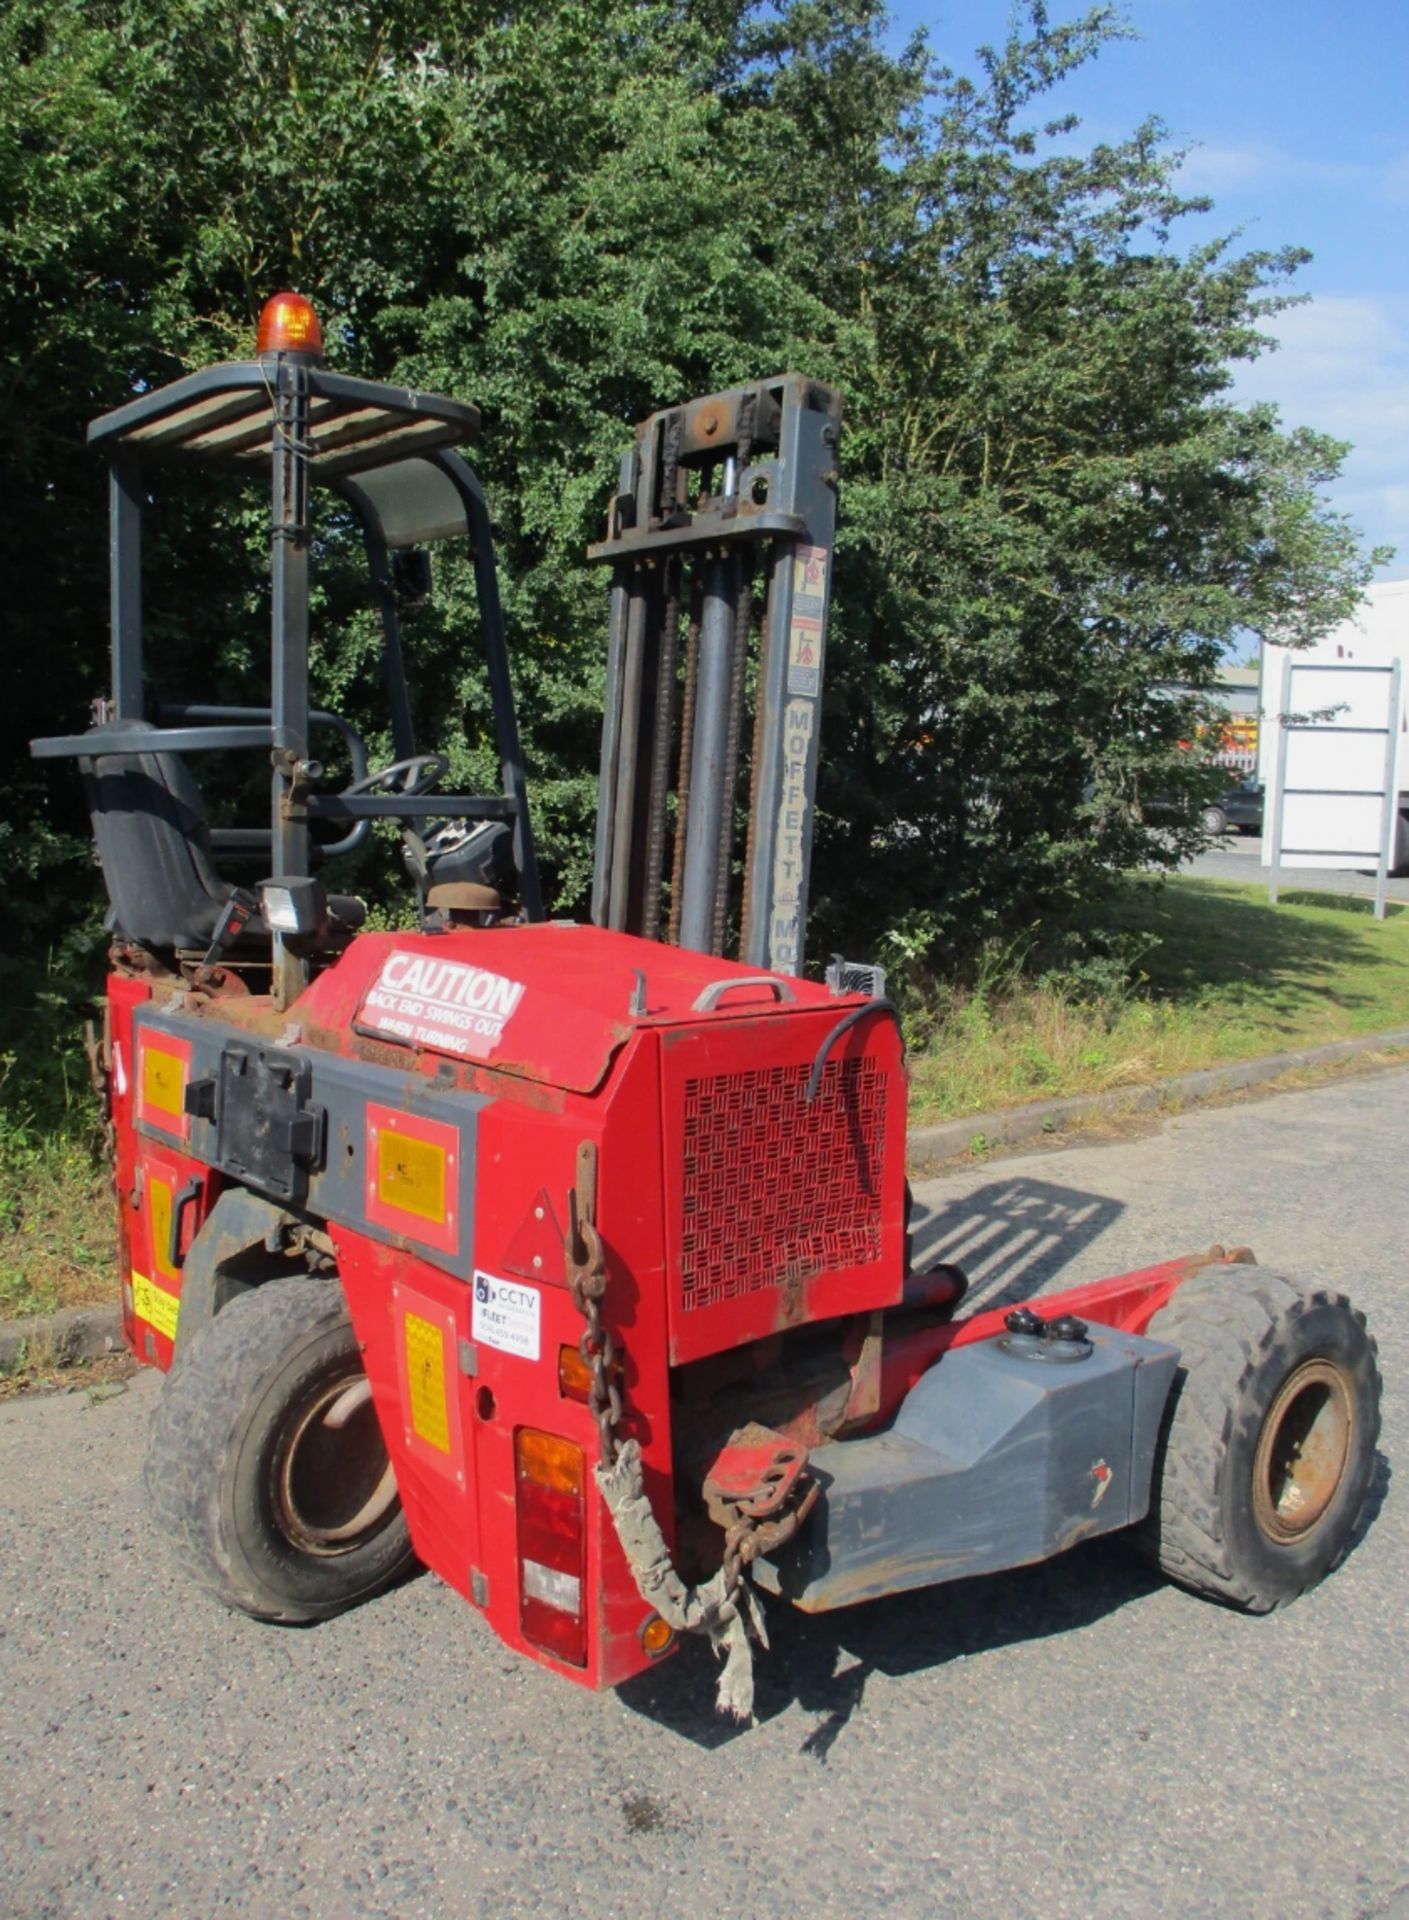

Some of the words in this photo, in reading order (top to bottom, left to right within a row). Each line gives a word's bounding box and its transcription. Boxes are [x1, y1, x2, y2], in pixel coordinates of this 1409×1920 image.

[782, 709, 809, 879] MOFFETT
[381, 955, 522, 1015] CAUTION
[365, 990, 396, 1010] BACK
[398, 998, 424, 1017] END
[424, 1005, 474, 1030] SWINGS
[475, 1017, 504, 1038] OUT
[377, 1016, 413, 1038] WHEN
[415, 1026, 470, 1053] TURNING
[498, 1287, 536, 1309] CCTV
